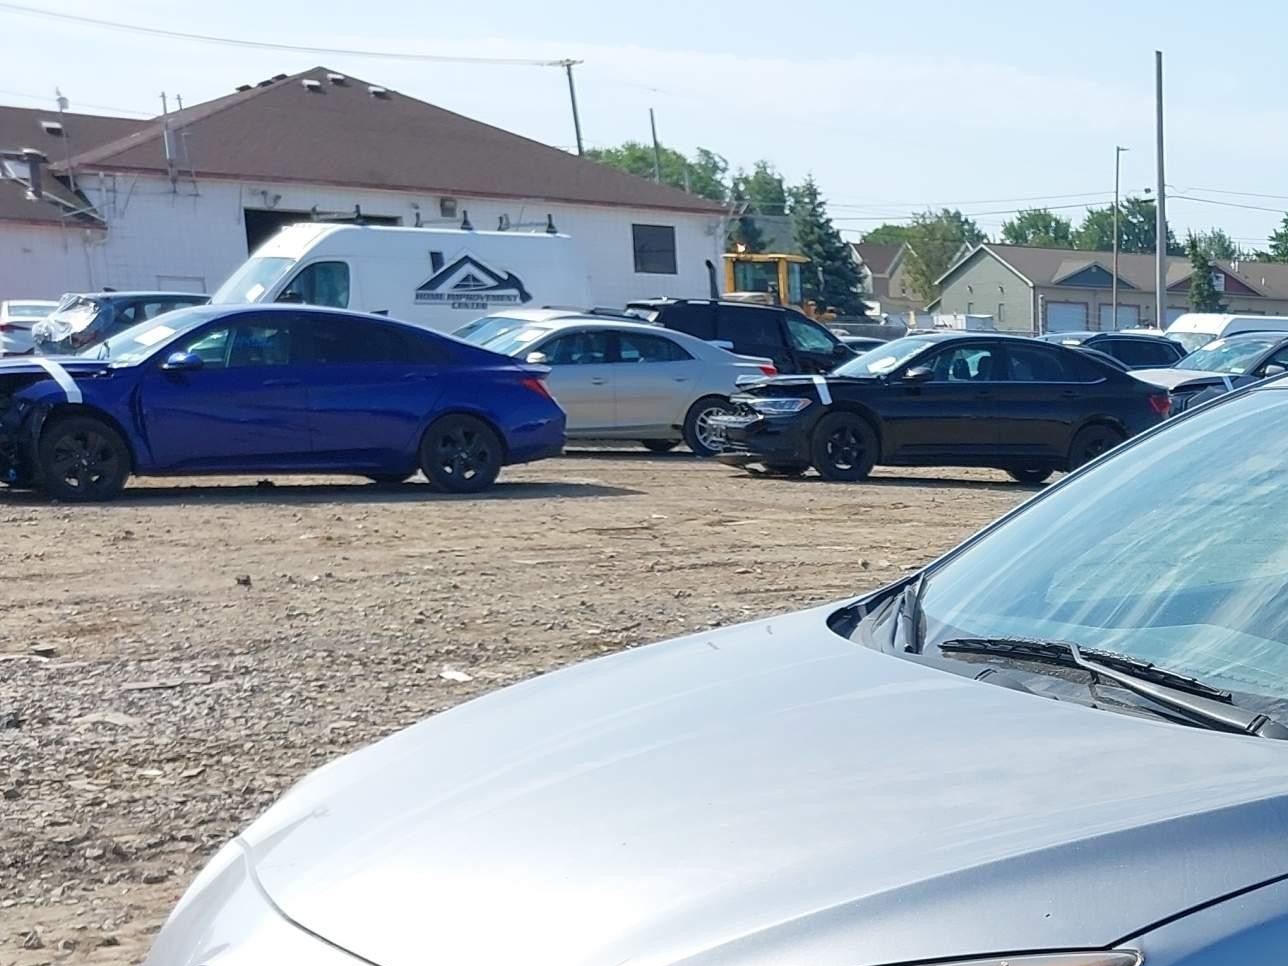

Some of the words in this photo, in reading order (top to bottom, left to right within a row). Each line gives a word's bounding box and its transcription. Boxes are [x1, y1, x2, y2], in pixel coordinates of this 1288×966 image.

[415, 292, 443, 301] HOME
[446, 293, 519, 302] IMPROVEMENT
[451, 302, 489, 310] CENTER
